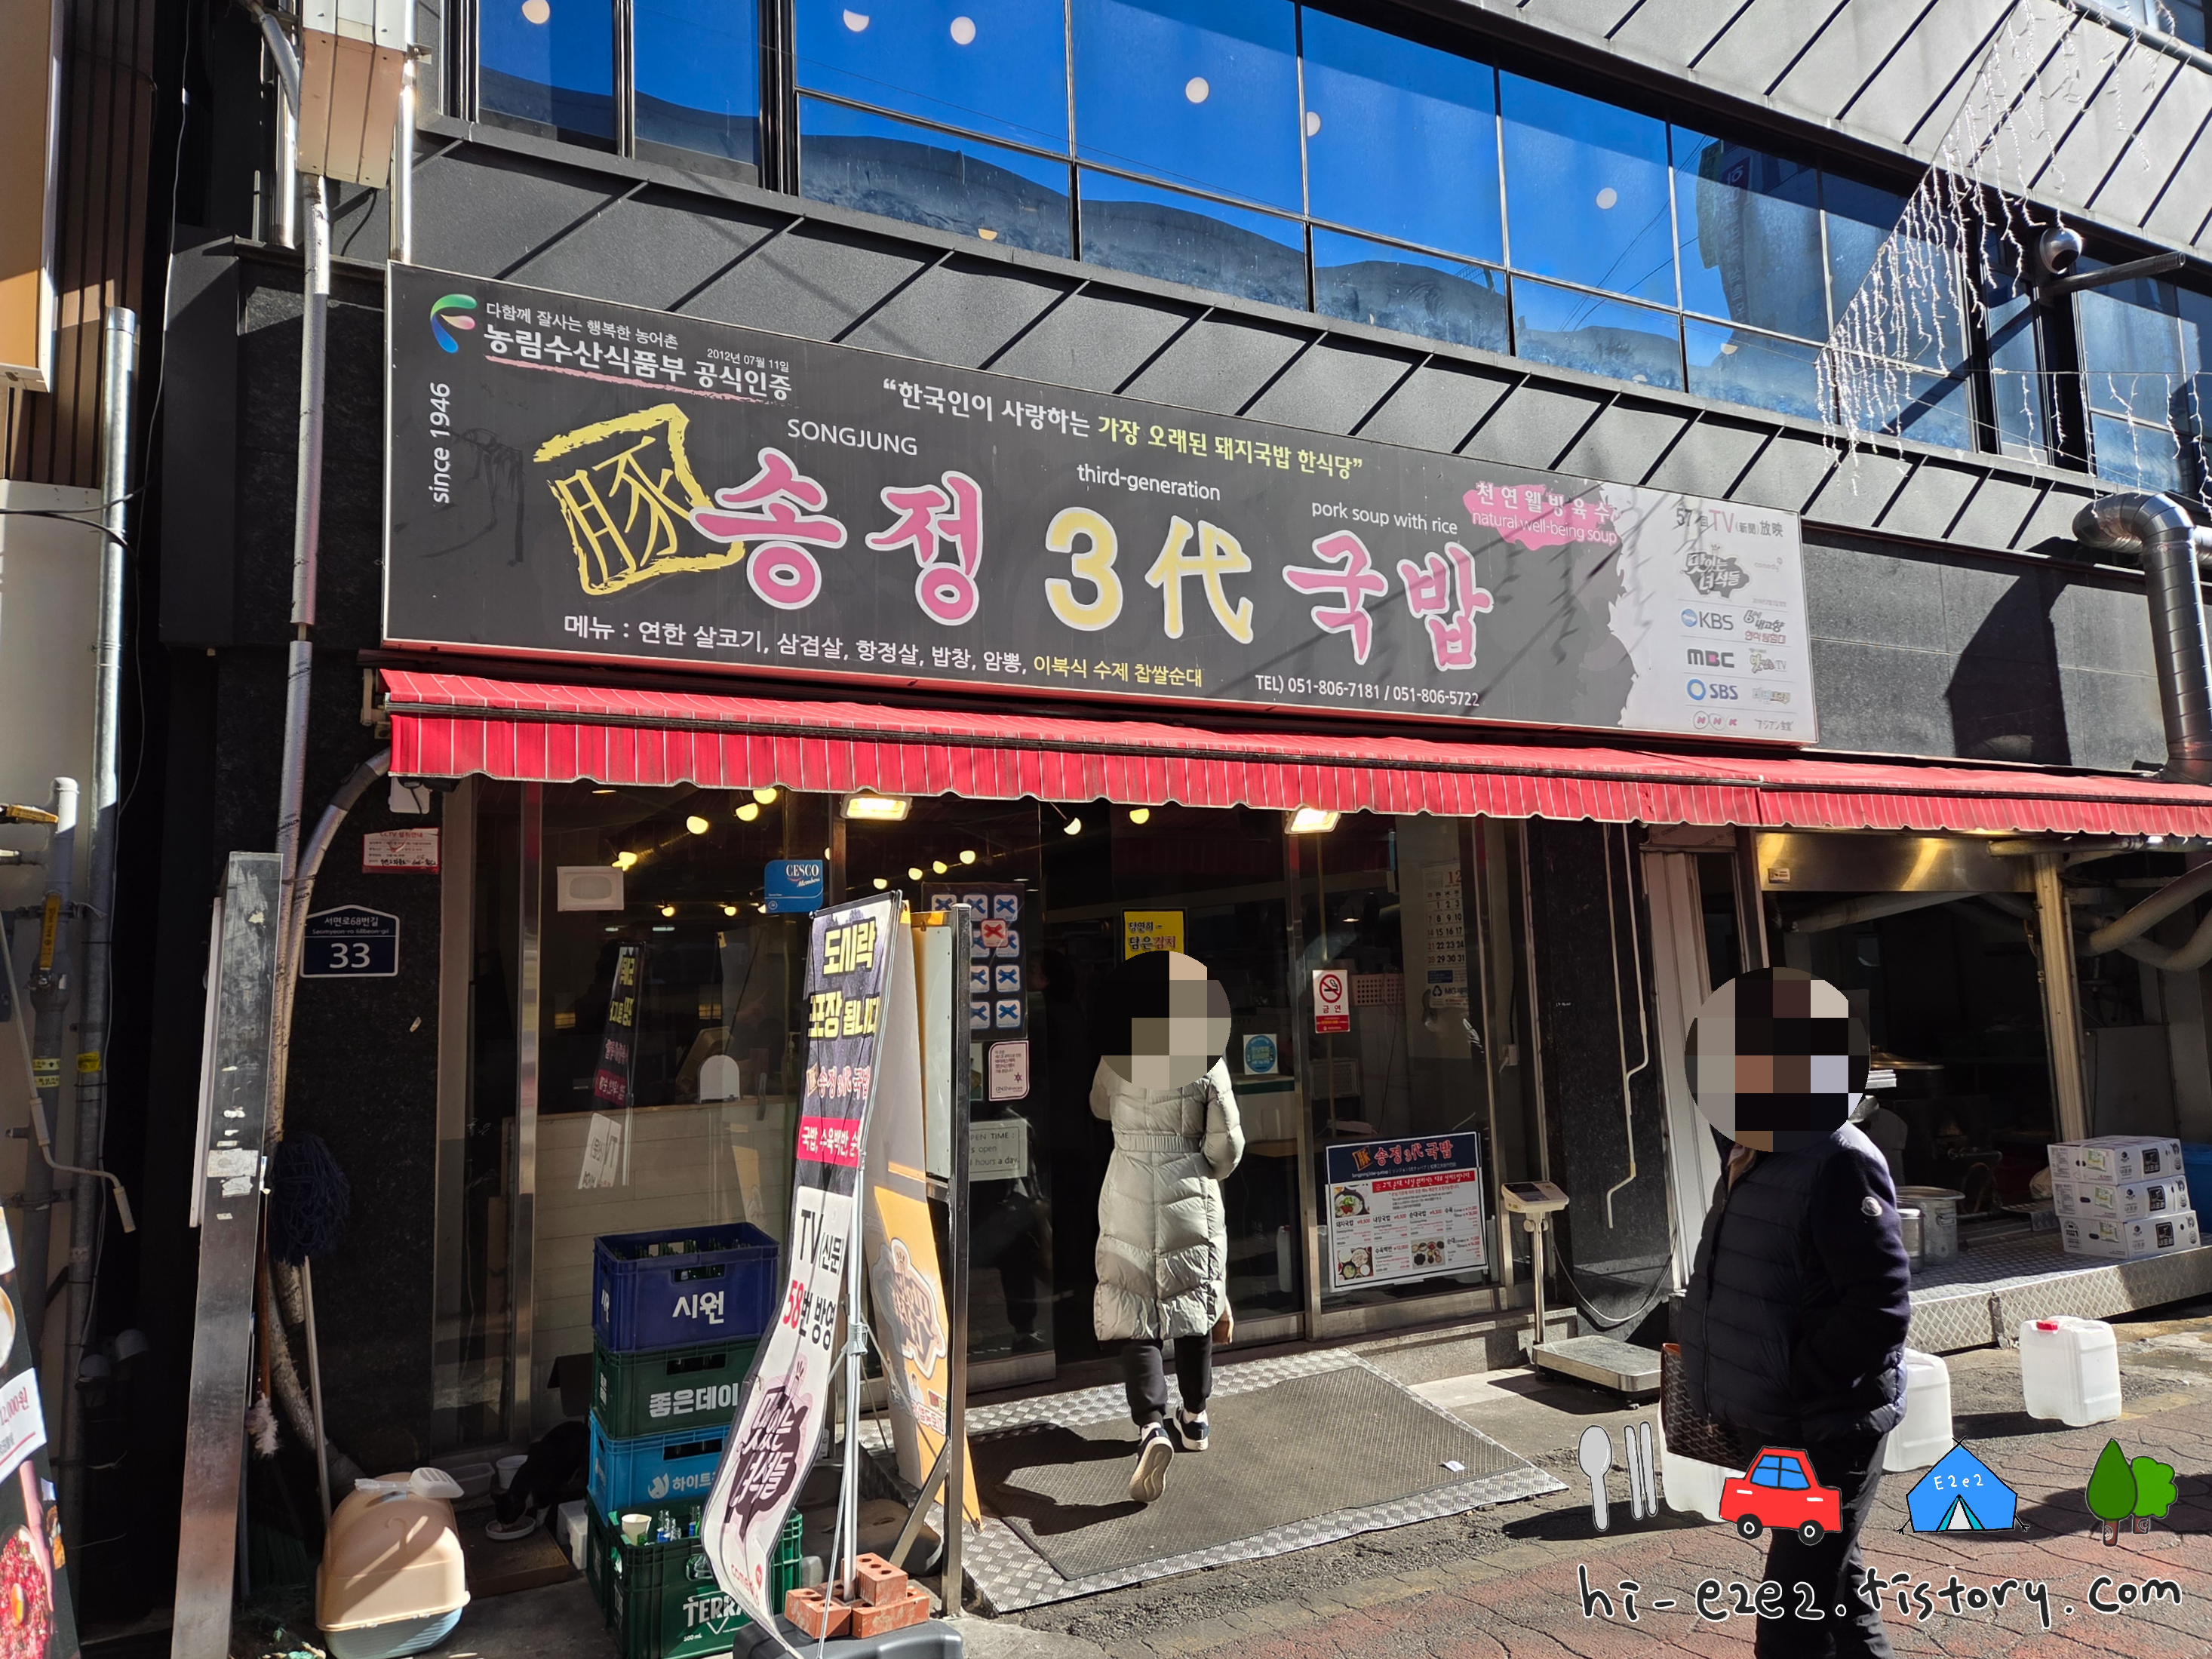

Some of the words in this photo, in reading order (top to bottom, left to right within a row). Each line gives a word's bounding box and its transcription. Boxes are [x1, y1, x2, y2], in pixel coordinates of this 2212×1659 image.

[487, 302, 531, 324] 다함께
[536, 310, 582, 333] 잘사는
[586, 319, 631, 342] 행복한
[634, 327, 678, 350] 농어촌
[484, 324, 687, 382] 농림수산식품부
[694, 360, 792, 401] 공식인증
[707, 348, 741, 364] 2012년
[743, 355, 765, 369] 07월
[768, 359, 789, 373] 11일
[429, 382, 450, 438] 1946
[787, 419, 917, 456] SONGJUNG
[883, 378, 993, 422] “한국인이
[1001, 400, 1091, 438] 사랑하는
[1098, 416, 1141, 447] 가장
[1147, 425, 1208, 457] 오래된
[1215, 436, 1292, 470] 돼지국밥
[1298, 448, 1363, 480] 한식당”
[428, 453, 450, 504] since
[1076, 462, 1221, 501] third-generation
[1312, 502, 1348, 519] pork
[1352, 508, 1390, 527] soup
[1393, 512, 1427, 530] with
[1432, 517, 1458, 535] rice
[1472, 511, 1518, 529] natural
[1520, 518, 1584, 540] well-being
[1587, 528, 1618, 546] soup
[689, 447, 983, 626] 송정
[1282, 530, 1495, 673] 국밥
[1699, 571, 1740, 591] 녀석들
[1698, 610, 1734, 631] KBS
[564, 615, 615, 641] 메뉴
[638, 621, 687, 647] 연한
[693, 625, 769, 654] 살코기,
[776, 633, 849, 661] 삼겹살,
[856, 640, 924, 667] 항정살,
[932, 646, 976, 671] 밥창,
[983, 651, 1027, 675] 암뽕,
[1034, 655, 1087, 679] 이북식
[1092, 660, 1129, 682] 수제
[1134, 662, 1202, 688] 찹쌀순대
[1686, 648, 1735, 669] MBC
[1255, 674, 1284, 694] TEL)
[1288, 677, 1380, 700] 051-806-7181
[1393, 686, 1479, 707] 051-806-5722
[1709, 683, 1739, 700] SBS
[786, 864, 819, 877] CESCO
[324, 917, 379, 927] 서면로68번길
[1129, 921, 1154, 932] 당연히
[329, 942, 370, 969] 33
[823, 920, 877, 975] 도시락
[808, 991, 843, 1038] 포장
[817, 1065, 837, 1099] 송정
[852, 1065, 871, 1101] 국밥
[801, 1126, 819, 1154] 국밥,
[849, 1130, 859, 1158] 순
[979, 1145, 997, 1154] open
[1373, 1144, 1403, 1167] 송정
[1425, 1139, 1454, 1161] 국밥
[975, 1157, 997, 1166] hours
[671, 1290, 725, 1326] 시원
[782, 1279, 813, 1338] 58번
[811, 1295, 837, 1351] 방영
[649, 1382, 739, 1418] 좋은데이
